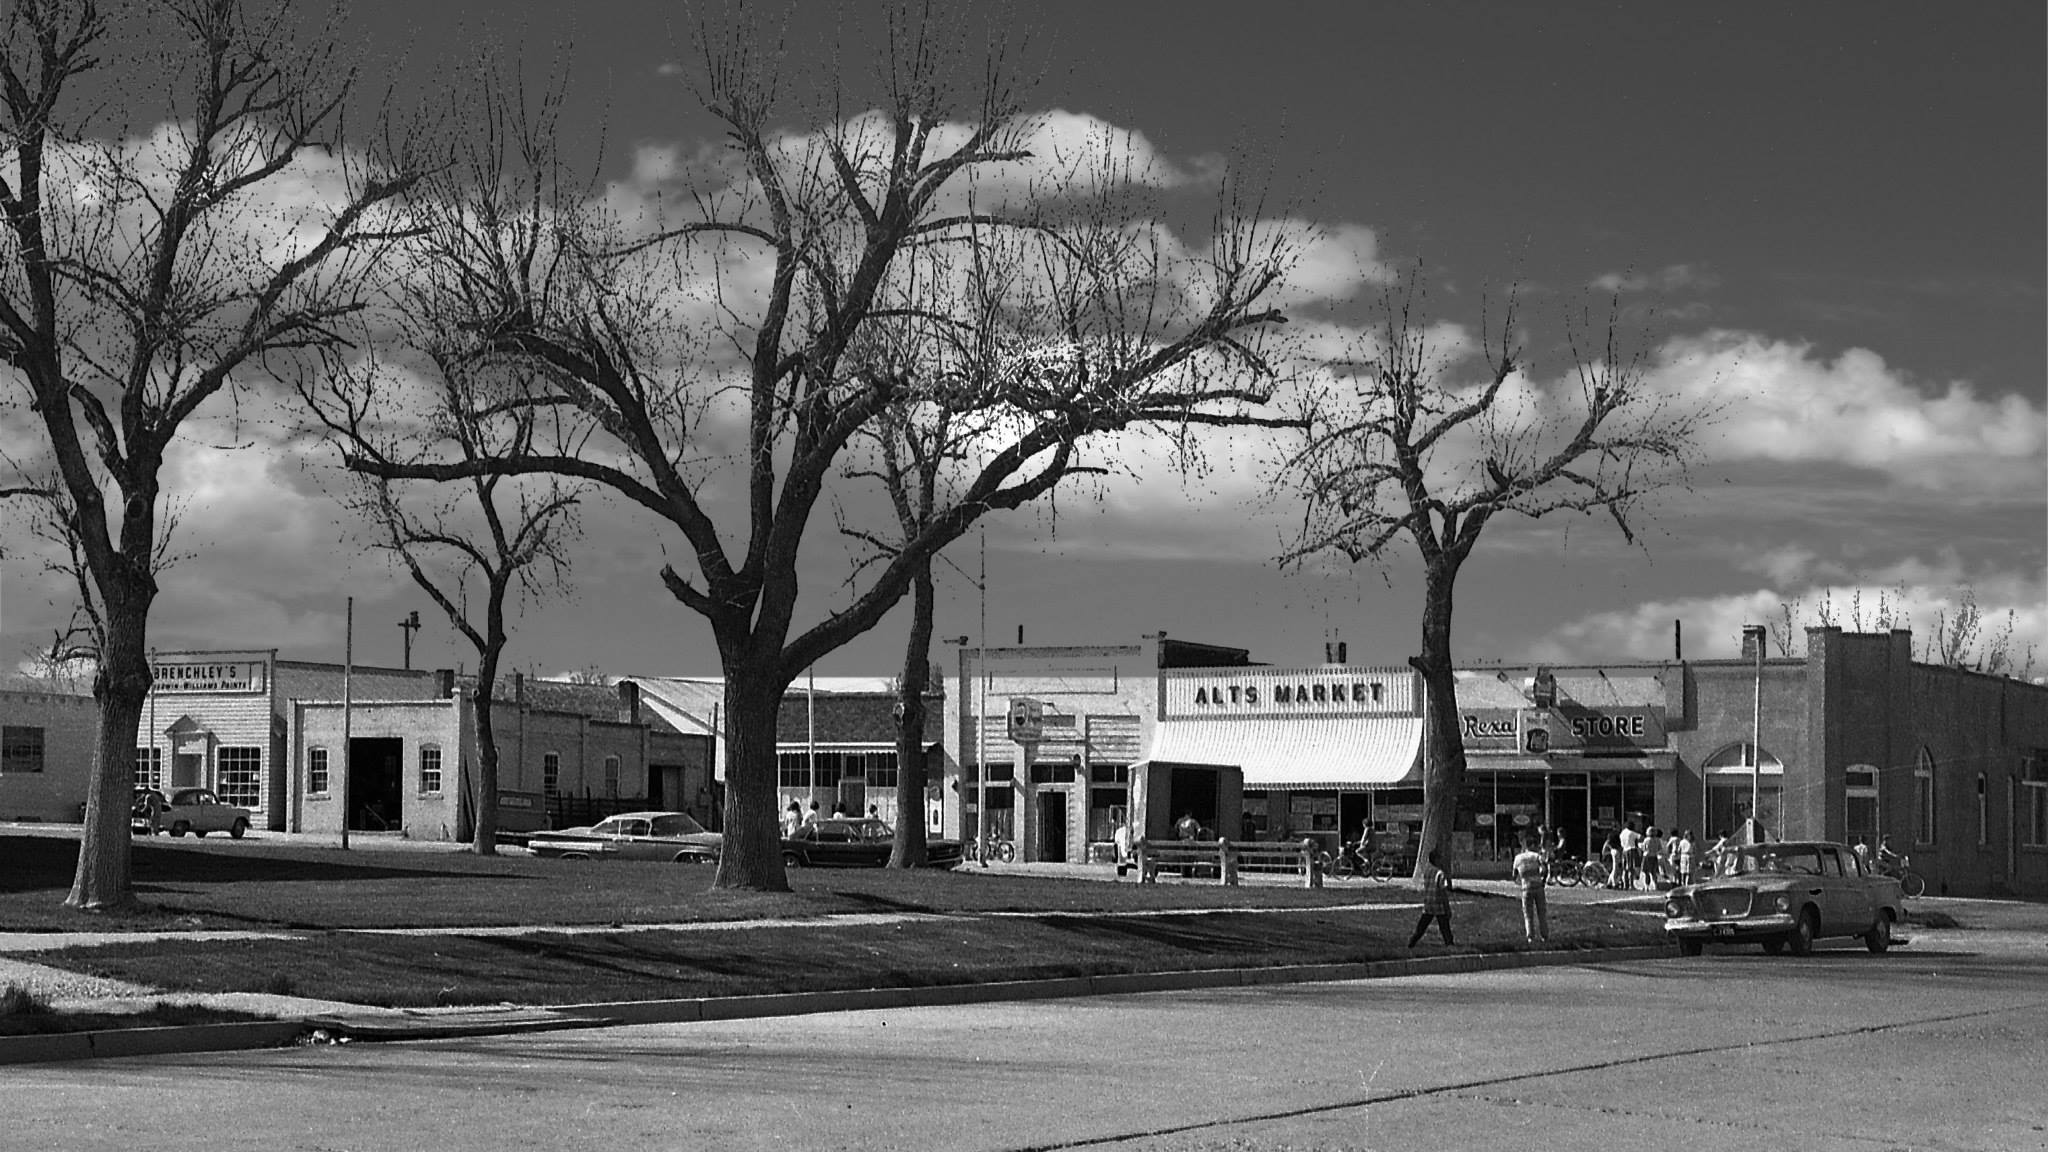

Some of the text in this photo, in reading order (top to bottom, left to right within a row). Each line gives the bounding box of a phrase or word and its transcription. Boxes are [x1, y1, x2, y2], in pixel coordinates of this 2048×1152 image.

[154, 665, 236, 679] BRENCHLEY'S
[1195, 683, 1382, 704] ALTS MARKET
[1463, 715, 1645, 738] Rexal STORE
